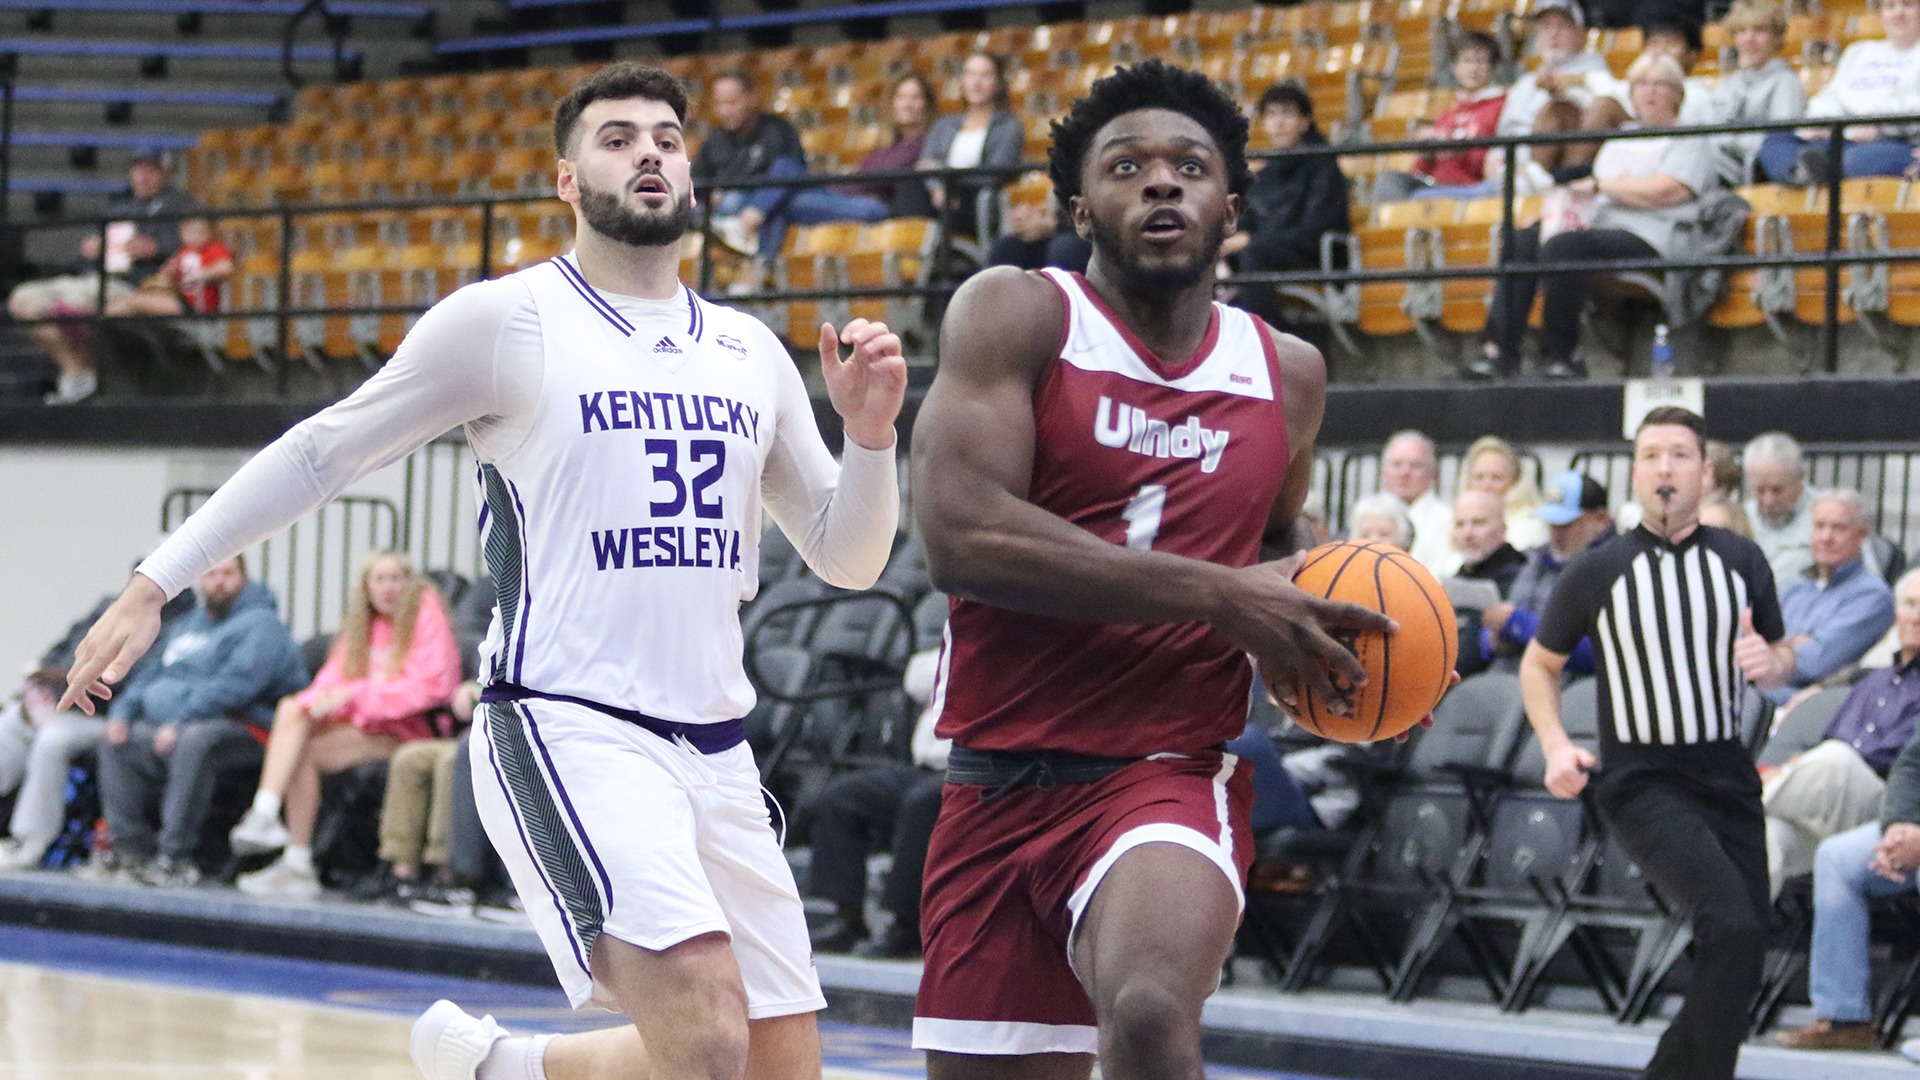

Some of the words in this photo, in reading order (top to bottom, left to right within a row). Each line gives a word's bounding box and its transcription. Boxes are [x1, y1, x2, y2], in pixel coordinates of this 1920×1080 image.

[653, 346, 683, 354] adidas
[578, 391, 759, 444] KENTUCKY
[1094, 395, 1230, 474] UIndy
[644, 438, 726, 519] 32
[1121, 485, 1167, 551] 1
